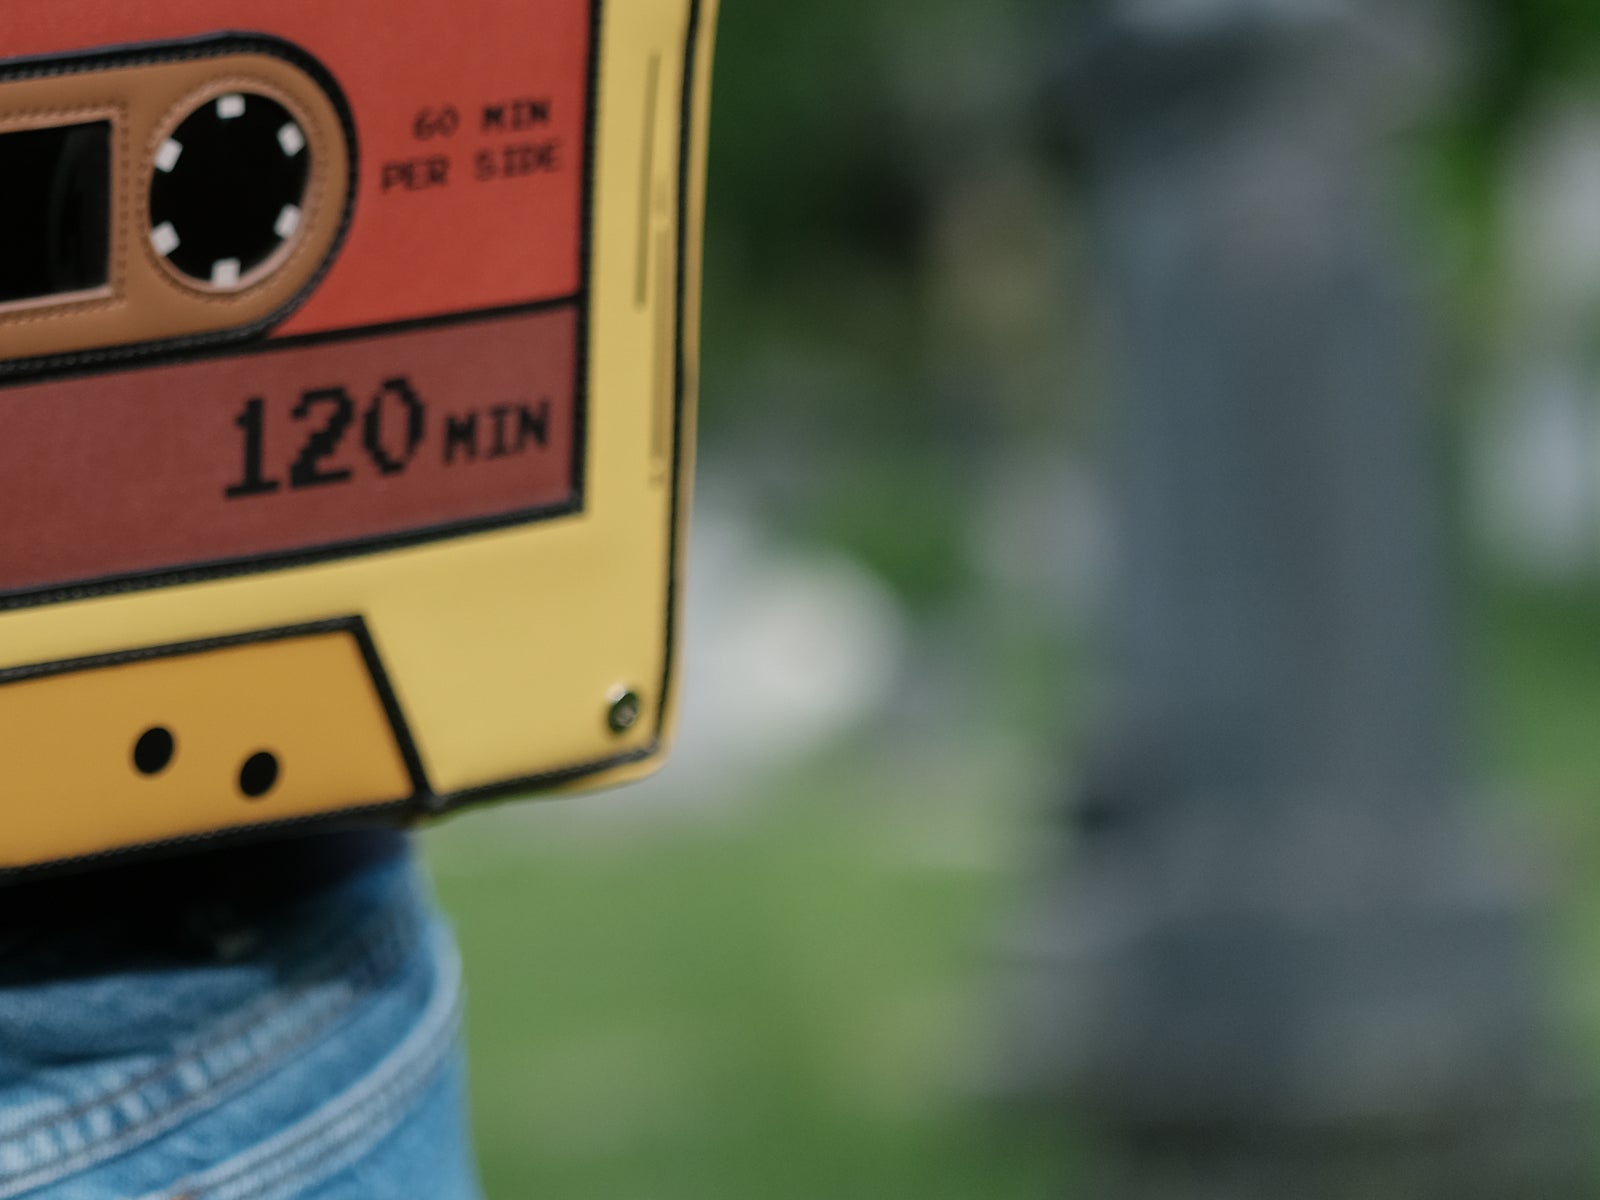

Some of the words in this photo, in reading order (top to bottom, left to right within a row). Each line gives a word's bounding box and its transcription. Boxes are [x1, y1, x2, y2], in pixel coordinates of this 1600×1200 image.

[411, 106, 461, 141] 60
[482, 97, 553, 132] MIN
[380, 156, 452, 195] PER
[473, 138, 561, 182] SIDE
[224, 374, 426, 499] 120
[441, 399, 552, 467] MIN
